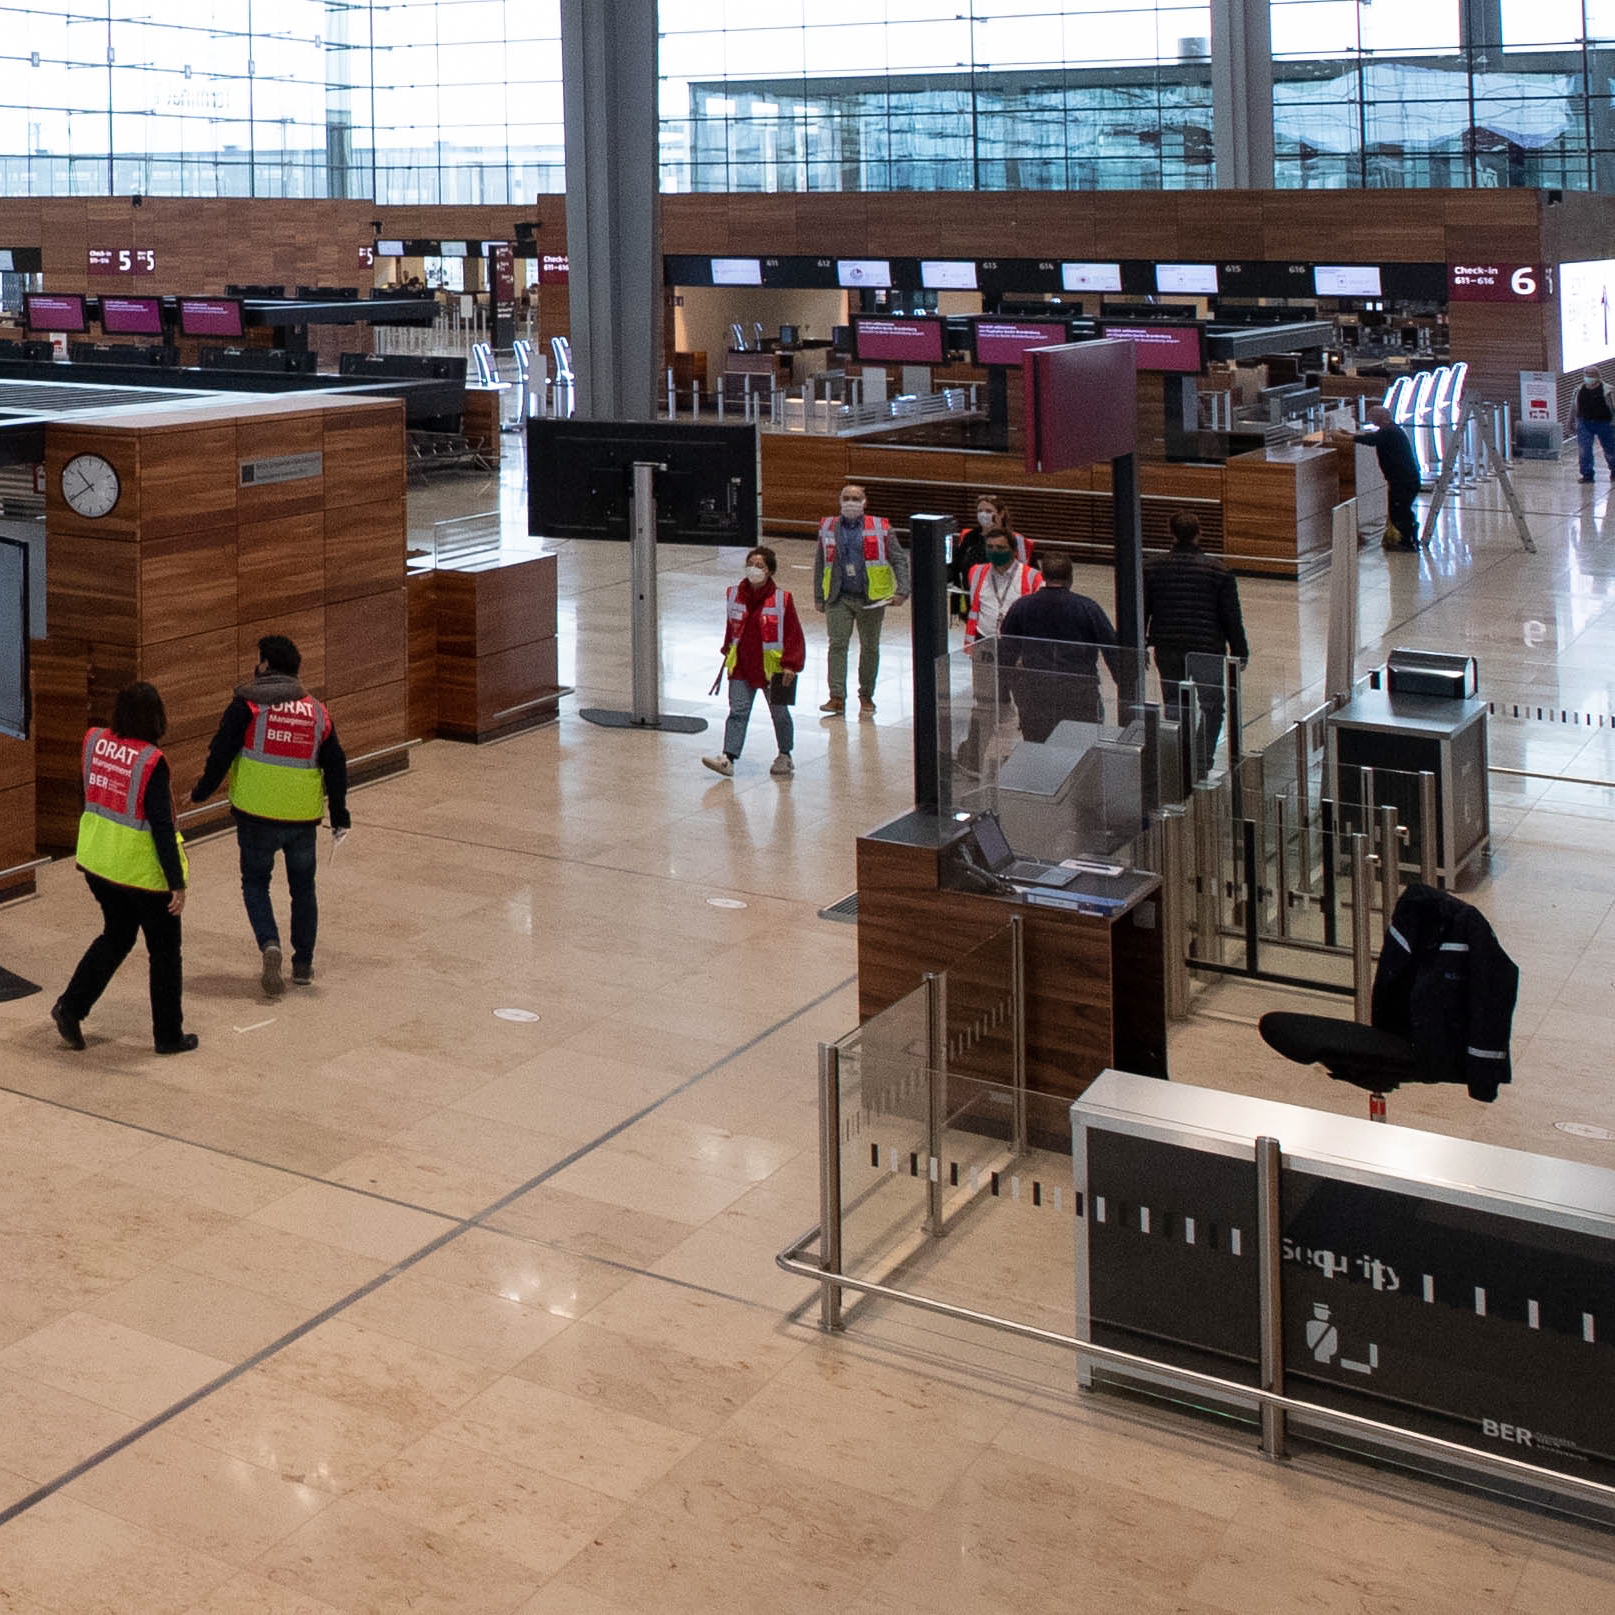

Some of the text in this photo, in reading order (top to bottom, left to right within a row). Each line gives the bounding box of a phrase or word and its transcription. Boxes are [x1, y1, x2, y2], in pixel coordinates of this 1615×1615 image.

[119, 250, 131, 271] 5
[146, 250, 155, 271] 5
[543, 255, 569, 263] Check-i
[817, 260, 831, 268] 612
[1039, 263, 1054, 271] 614
[1225, 265, 1242, 274] 615
[1288, 265, 1306, 274] 616
[1454, 266, 1499, 275] Check-in
[1511, 266, 1537, 295] 6
[270, 701, 314, 718] ORAT
[268, 714, 316, 728] Management
[267, 728, 292, 744] BER
[95, 738, 139, 767] ORAT
[92, 756, 133, 778] Management
[89, 772, 109, 790] BER
[1482, 1418, 1533, 1448] BER
